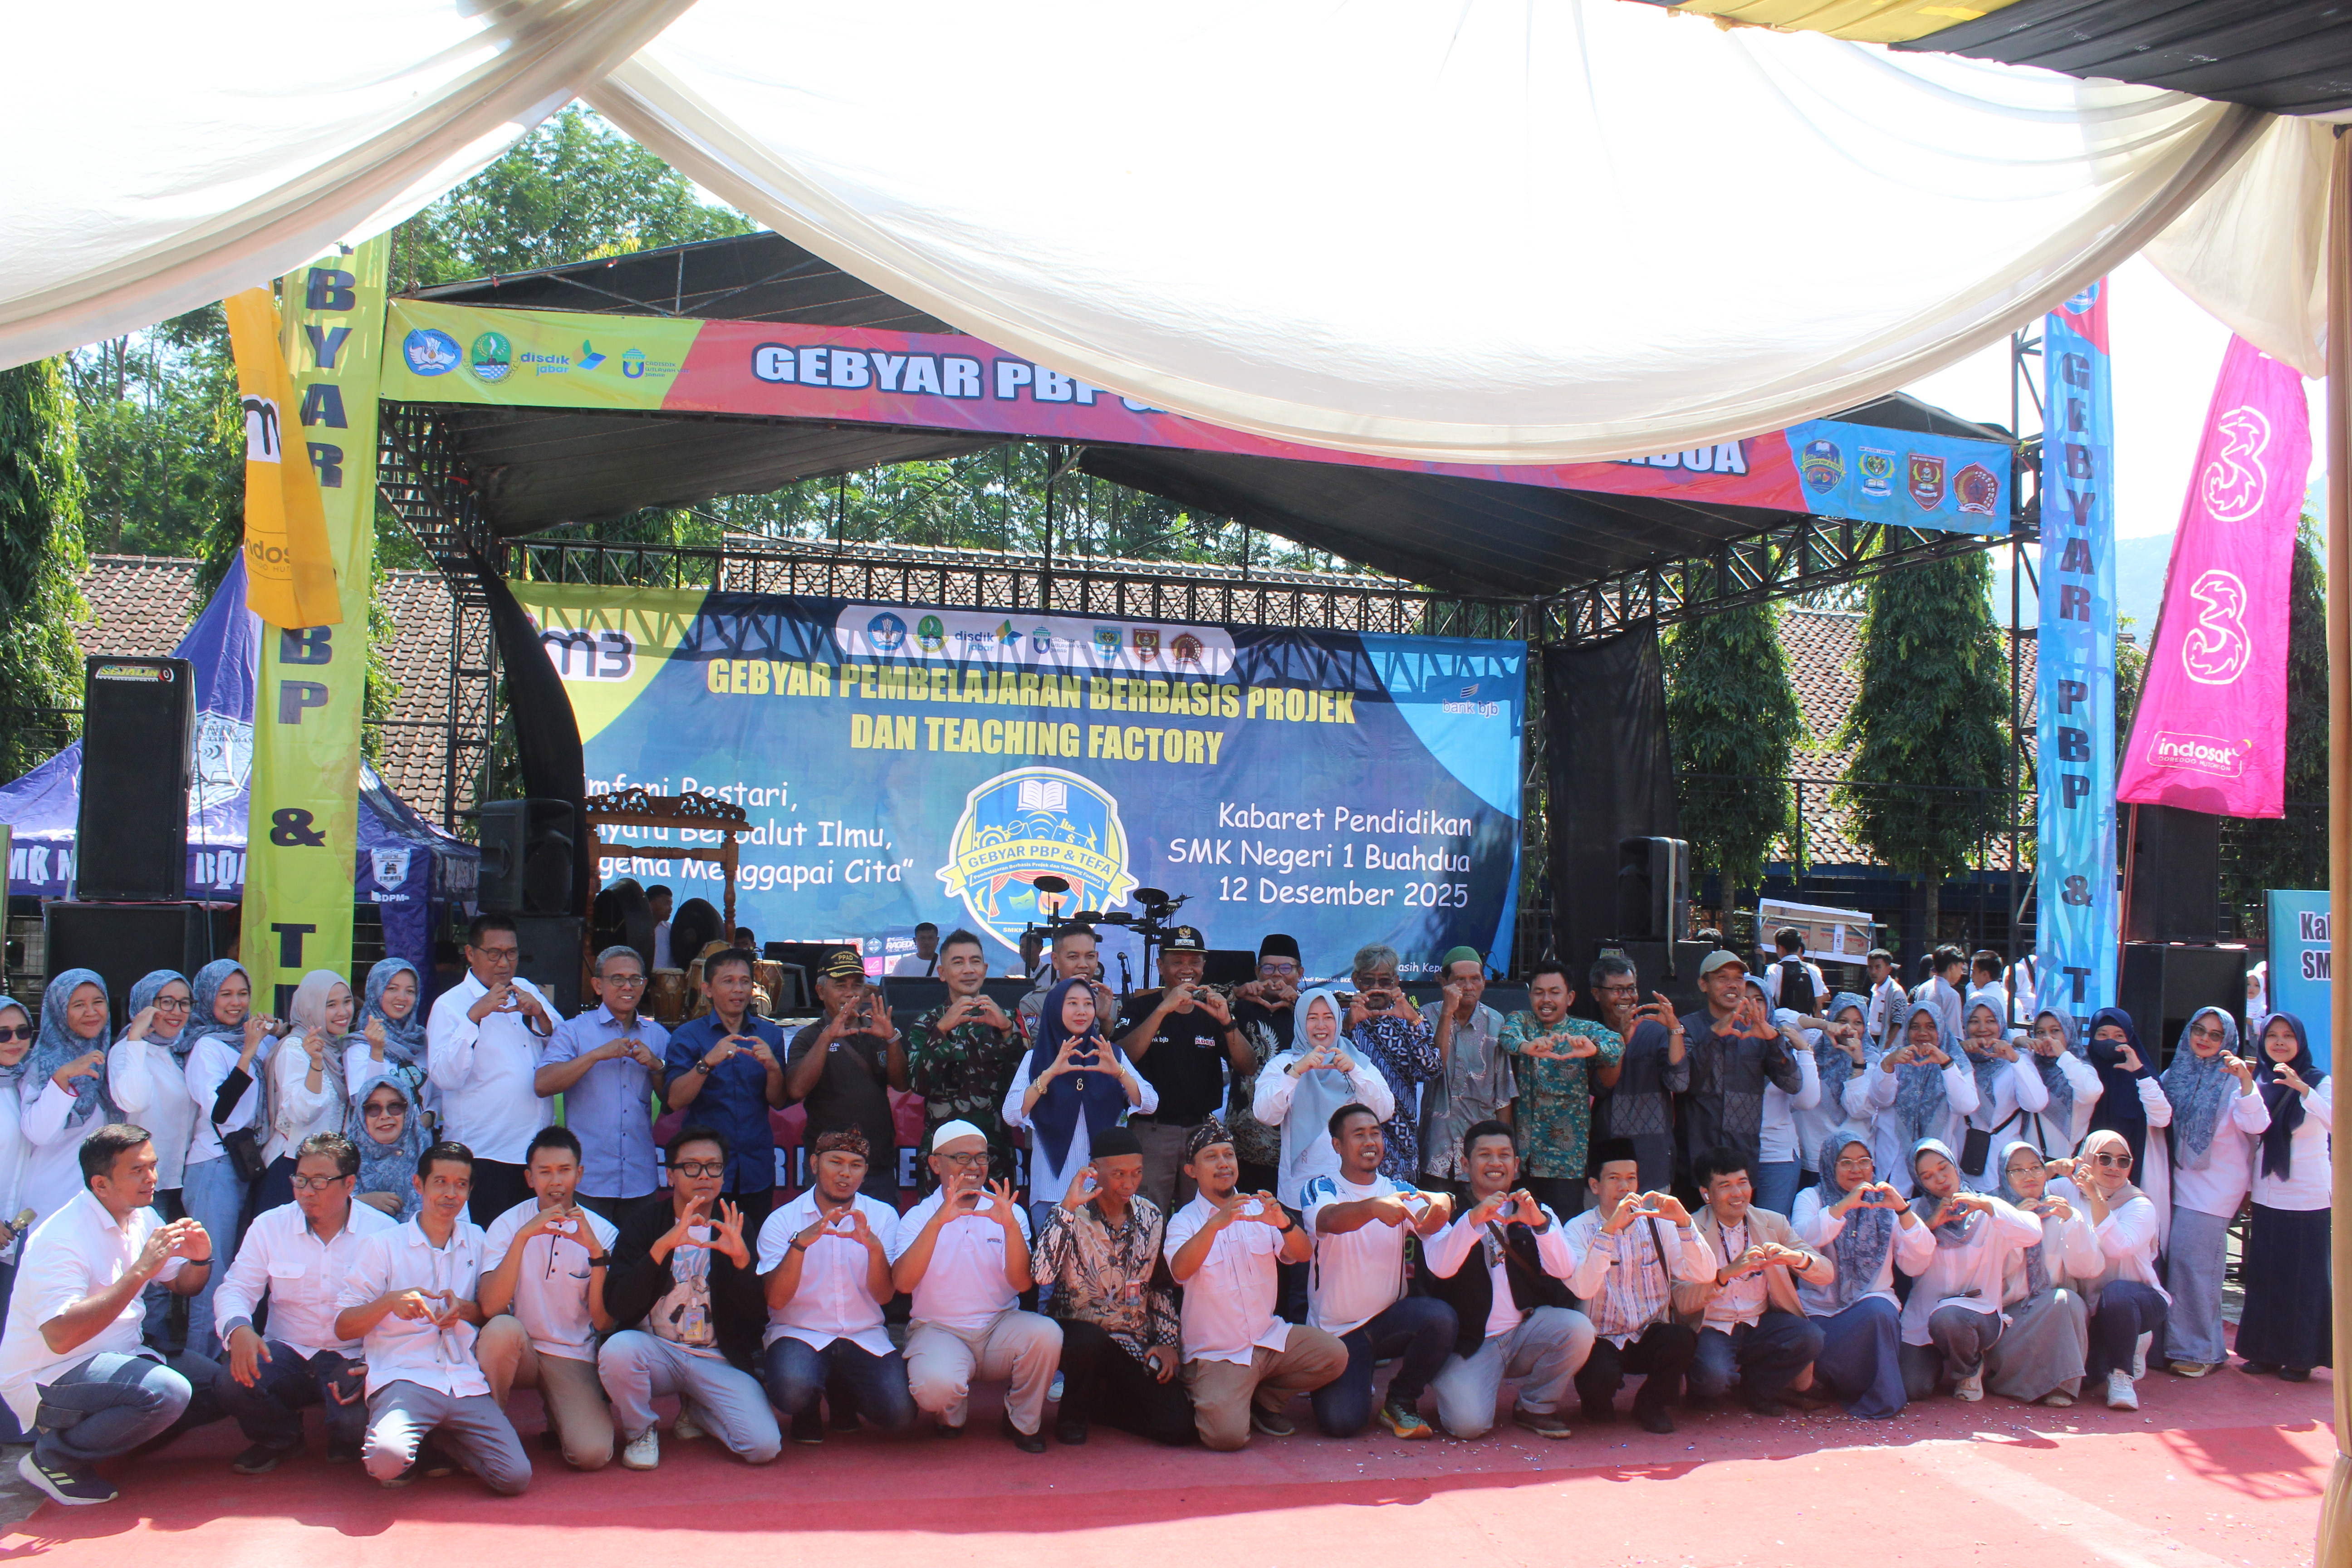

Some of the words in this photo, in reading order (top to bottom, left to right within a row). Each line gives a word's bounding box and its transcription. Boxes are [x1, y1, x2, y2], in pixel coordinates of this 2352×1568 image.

[302, 252, 356, 488] BYAR
[520, 352, 570, 365] disdik
[536, 364, 570, 377] jabar
[754, 345, 981, 398] GEBYAR
[2060, 352, 2096, 622] GEBYAR
[955, 630, 995, 643] disdik
[967, 642, 994, 653] jabar
[100, 667, 159, 677] SEJALIN
[279, 625, 333, 725] BP
[707, 658, 831, 697] GEBYAR
[839, 663, 1081, 709] PEMBELAJARAN
[1089, 676, 1240, 719] BERBASIS
[1246, 686, 1356, 724] PROJEK
[1443, 699, 1475, 714] bank
[1478, 701, 1499, 718] bjb
[850, 713, 916, 750] DAN
[925, 716, 1080, 758] TEACHING
[1088, 725, 1224, 765] FACTORY
[2058, 679, 2090, 809] PBP
[2158, 737, 2232, 765] indosat
[2158, 756, 2196, 764] OOREDOO
[270, 808, 326, 847] &
[1219, 802, 1325, 831] Kabaret
[1334, 806, 1472, 837] Pendidikan
[817, 820, 892, 851] Ilmu,
[968, 846, 1025, 868] GEBYAR
[1029, 845, 1061, 858] PBP
[1063, 849, 1075, 862] &
[1079, 853, 1111, 876] TEFA
[1167, 837, 1232, 865] SMK
[1241, 839, 1333, 874] Negeri
[1343, 843, 1354, 868] 1
[1365, 843, 1470, 873] Buahdua
[1060, 865, 1083, 876] Teaching
[1083, 872, 1101, 884] Factory
[1219, 876, 1248, 902] 12
[1259, 877, 1394, 906] Desember
[1403, 882, 1469, 909] 2025
[2061, 875, 2092, 907] &
[2300, 912, 2331, 941] Ka
[1398, 961, 1419, 972] asih
